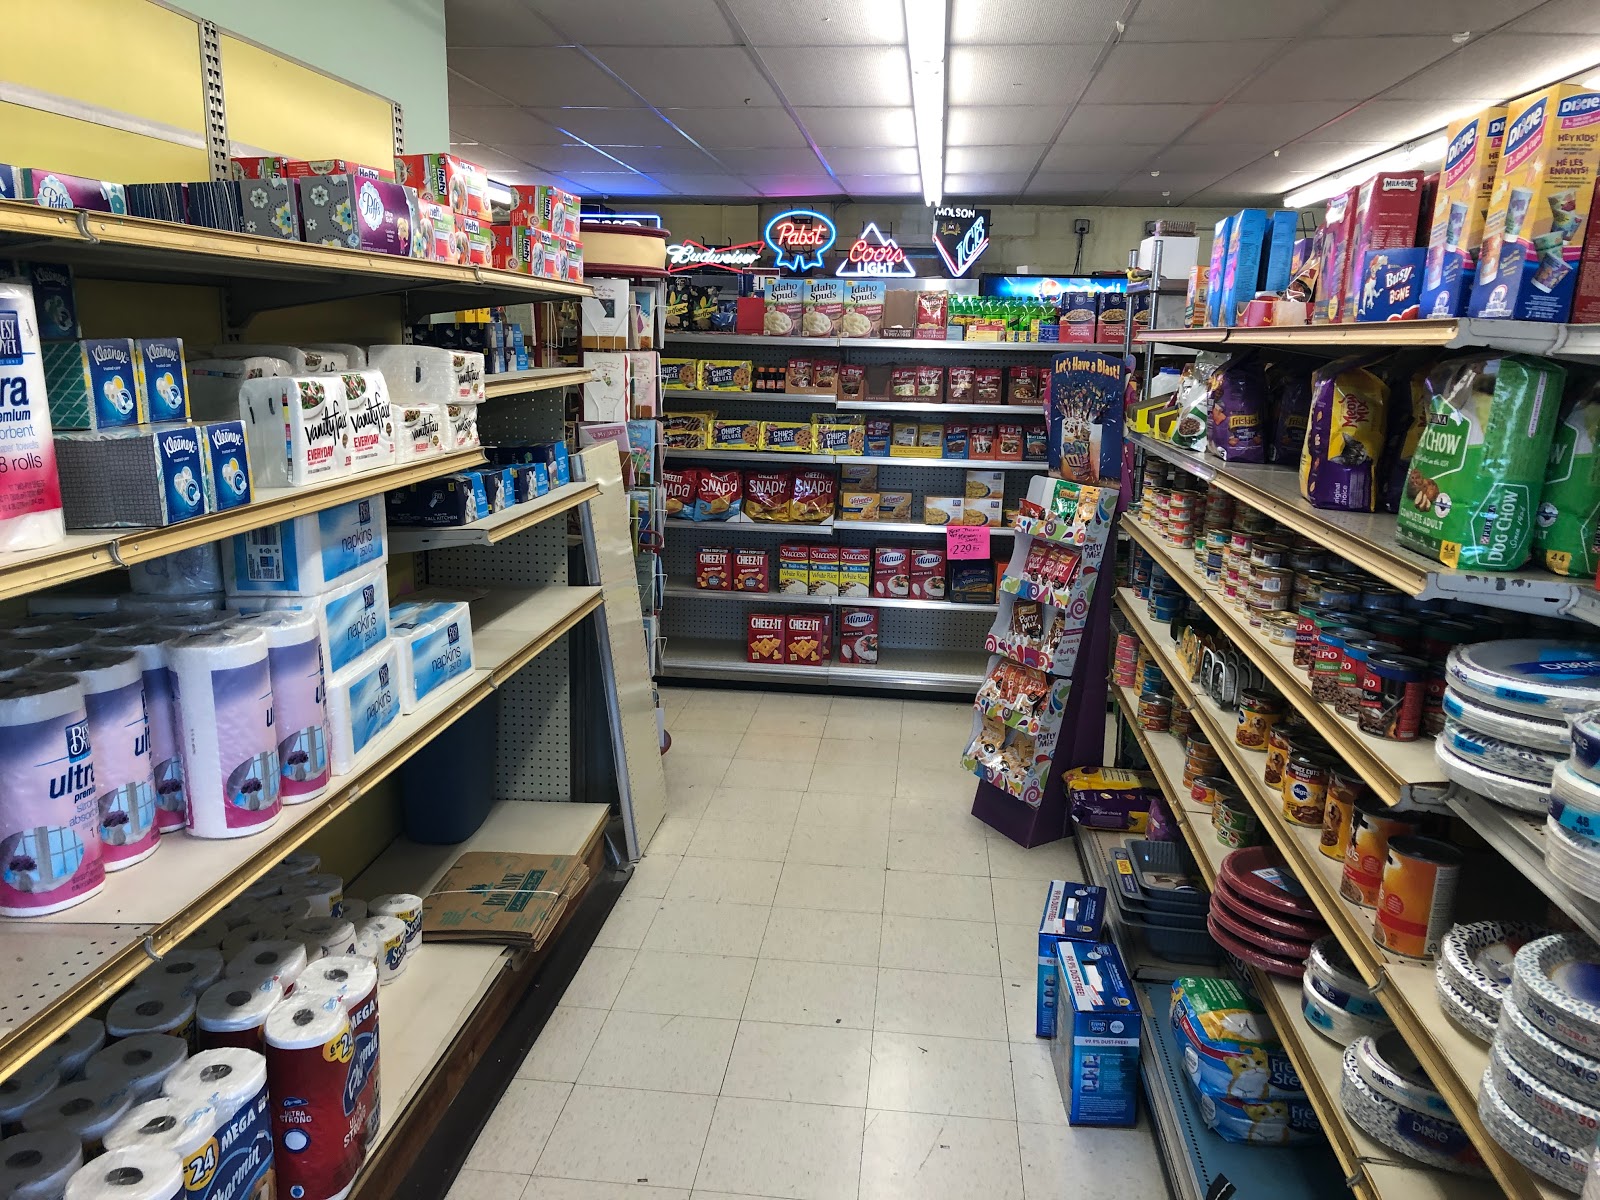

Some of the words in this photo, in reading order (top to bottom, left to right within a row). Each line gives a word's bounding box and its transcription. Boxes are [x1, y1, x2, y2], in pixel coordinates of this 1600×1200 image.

[1576, 134, 1598, 142] KIDS!
[438, 168, 447, 195] Hefty
[363, 192, 381, 219] Puffs
[936, 208, 976, 218] MOLSON
[465, 220, 479, 234] Hefty
[777, 223, 827, 246] Pabst
[956, 216, 985, 269] ICE
[667, 244, 761, 264] Budweiser
[849, 239, 903, 263] Coors
[857, 262, 895, 275] LIGHT
[772, 282, 797, 293] Idaho
[811, 282, 836, 293] Idaho
[852, 284, 877, 295] Idaho
[771, 291, 797, 302] Spuds
[810, 291, 836, 302] Spuds
[851, 293, 877, 304] Spuds
[1389, 286, 1410, 304] BONE
[92, 346, 127, 364] Kleenex
[146, 345, 177, 362] Kleenex
[712, 369, 732, 377] CHIPS
[1056, 357, 1071, 374] Let's
[1072, 356, 1090, 371] Have
[1091, 361, 1096, 372] a
[1097, 359, 1121, 380] Blast!
[1342, 394, 1358, 429] Meow
[721, 427, 741, 435] CHIPS
[773, 430, 793, 438] CHIPS
[826, 432, 846, 440] CHIPS
[212, 430, 241, 449] Kleenex
[354, 434, 379, 447] EVERYDAY
[1427, 430, 1461, 455] CHOW
[163, 437, 195, 458] Kleenex
[308, 446, 333, 461] EVERYDAY
[12, 453, 43, 471] rolls
[1496, 490, 1518, 531] CHOW
[1423, 517, 1443, 531] ADULT
[342, 528, 373, 552] napkins
[1084, 543, 1103, 552] Party
[1488, 532, 1507, 562] DOG
[700, 554, 726, 564] CHEEZ-IT
[737, 555, 763, 565] CHEEZ-IT
[879, 554, 906, 565] Minute
[915, 555, 941, 566] Minute
[842, 572, 855, 580] White
[348, 611, 376, 640] napkins
[751, 618, 782, 629] CHEEZ-IT
[789, 619, 819, 631] CHEEZ-IT
[845, 614, 873, 625] Minute
[1019, 614, 1038, 625] Party
[1022, 621, 1036, 632] Mix
[432, 646, 461, 672] napkins
[367, 690, 391, 720] napkins
[1038, 732, 1056, 742] Party
[1070, 970, 1085, 996] DUST-FREE!
[351, 1000, 375, 1029] MEGA
[1558, 1024, 1588, 1044] ULTRA
[1275, 1073, 1299, 1086] Ste
[280, 1115, 312, 1123] STRONG
[1578, 1116, 1597, 1128] 30
[222, 1108, 256, 1152] MEGA
